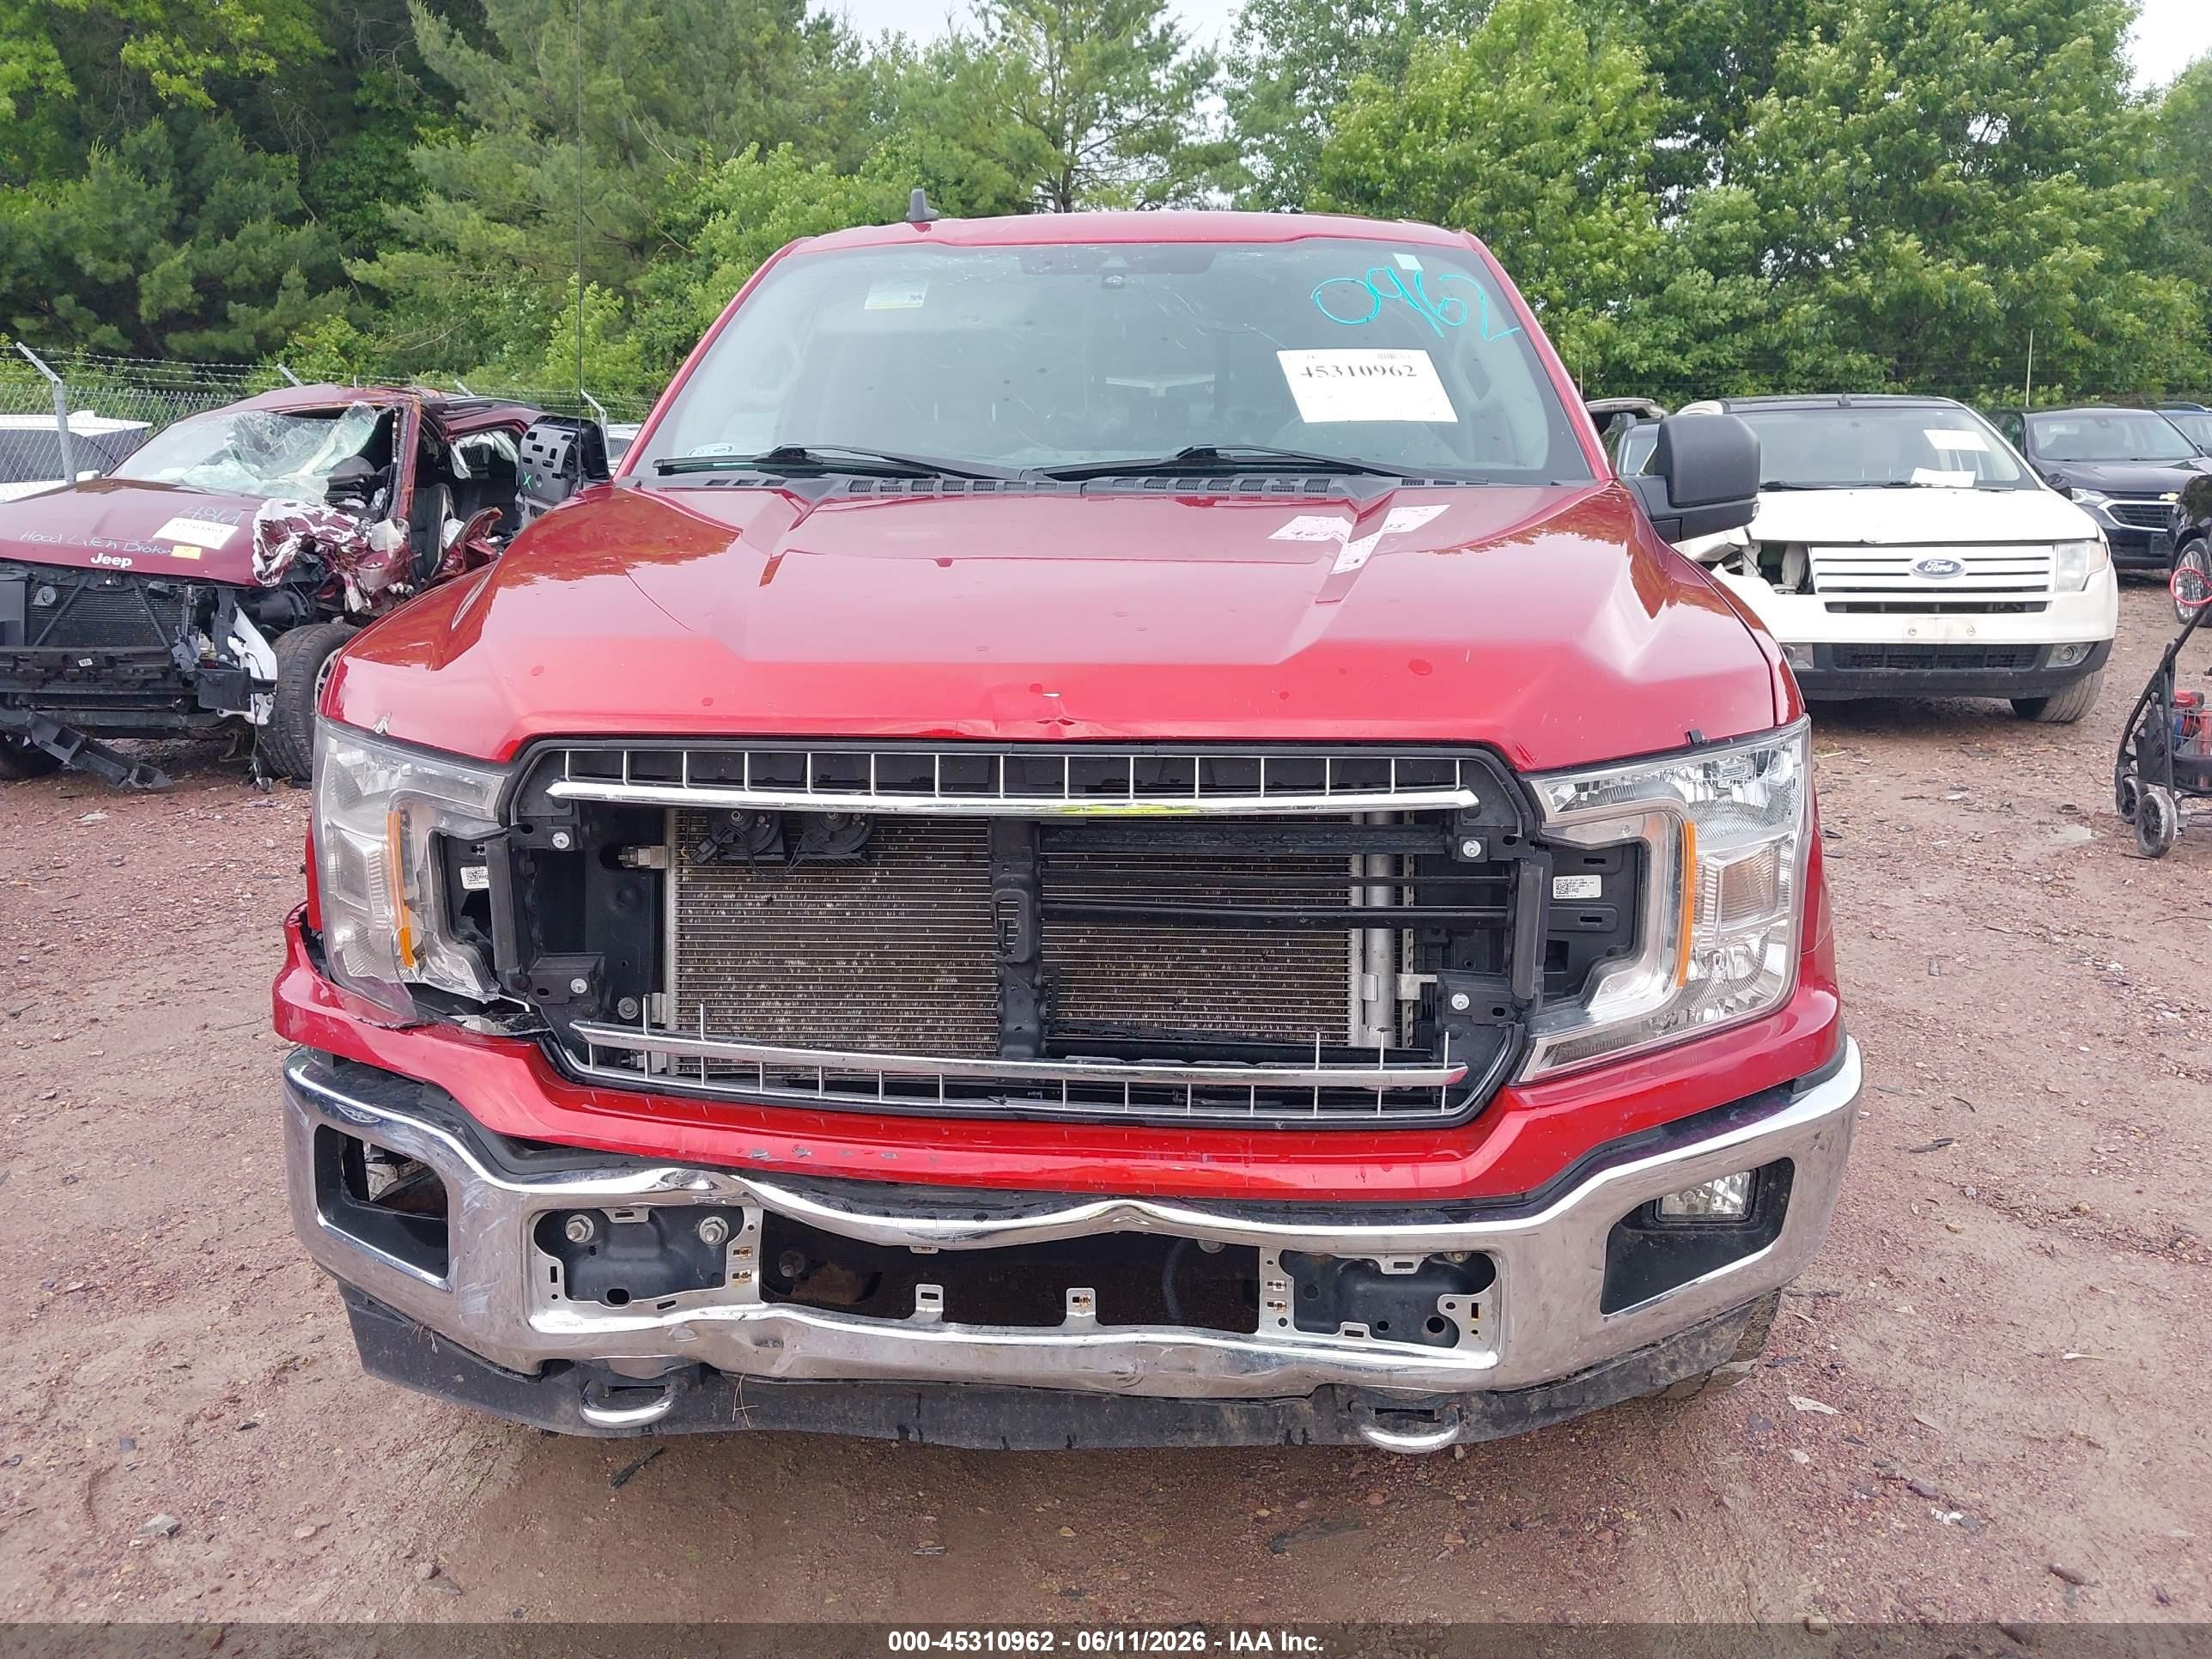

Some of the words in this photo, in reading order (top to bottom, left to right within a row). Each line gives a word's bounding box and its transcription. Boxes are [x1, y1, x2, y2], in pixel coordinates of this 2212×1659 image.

[1310, 266, 1520, 342] 0962
[1300, 364, 1417, 379] 45310962
[90, 552, 133, 568] Jeep
[1924, 560, 1954, 573] Ford
